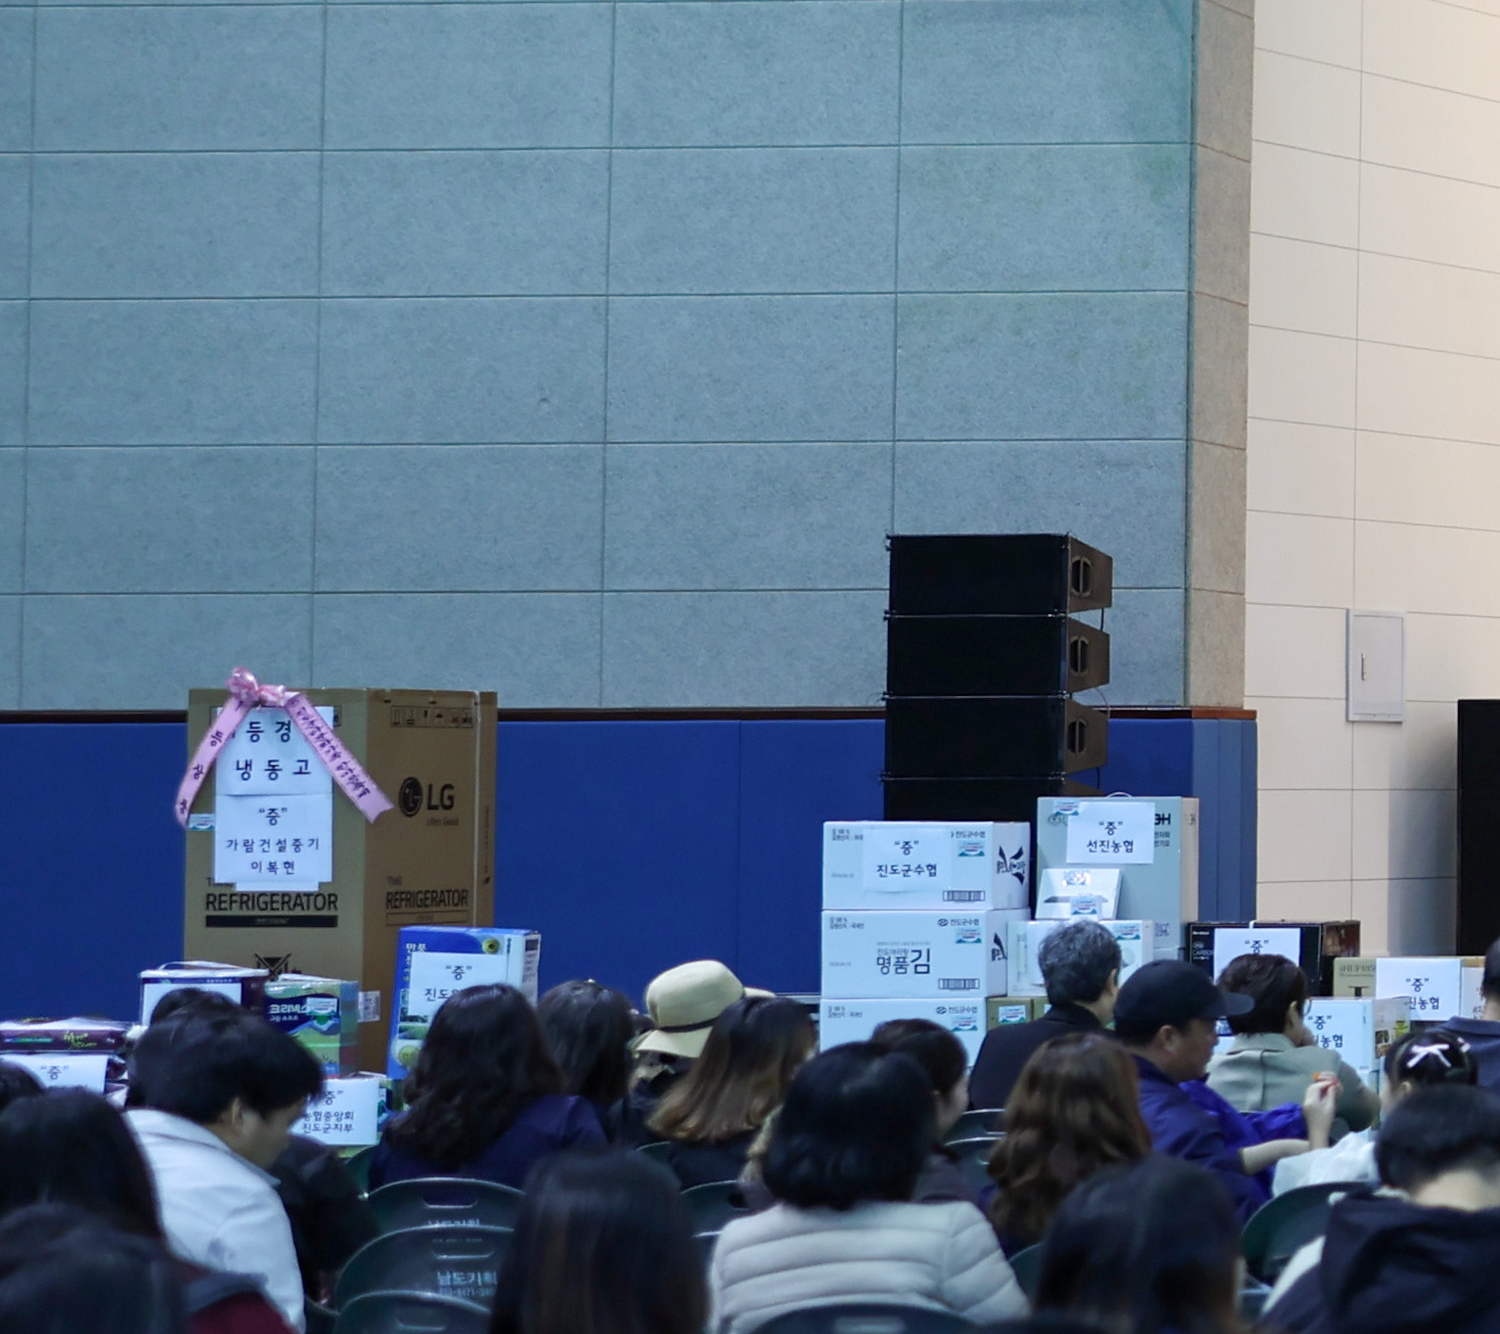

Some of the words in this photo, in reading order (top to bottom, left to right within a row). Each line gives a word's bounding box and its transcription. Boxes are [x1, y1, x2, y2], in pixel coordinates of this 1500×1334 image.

[426, 783, 455, 811] LG
[875, 864, 938, 878] 진도군수협
[205, 893, 339, 912] REFRIGERATOR
[385, 889, 469, 910] REFRIGERATOR
